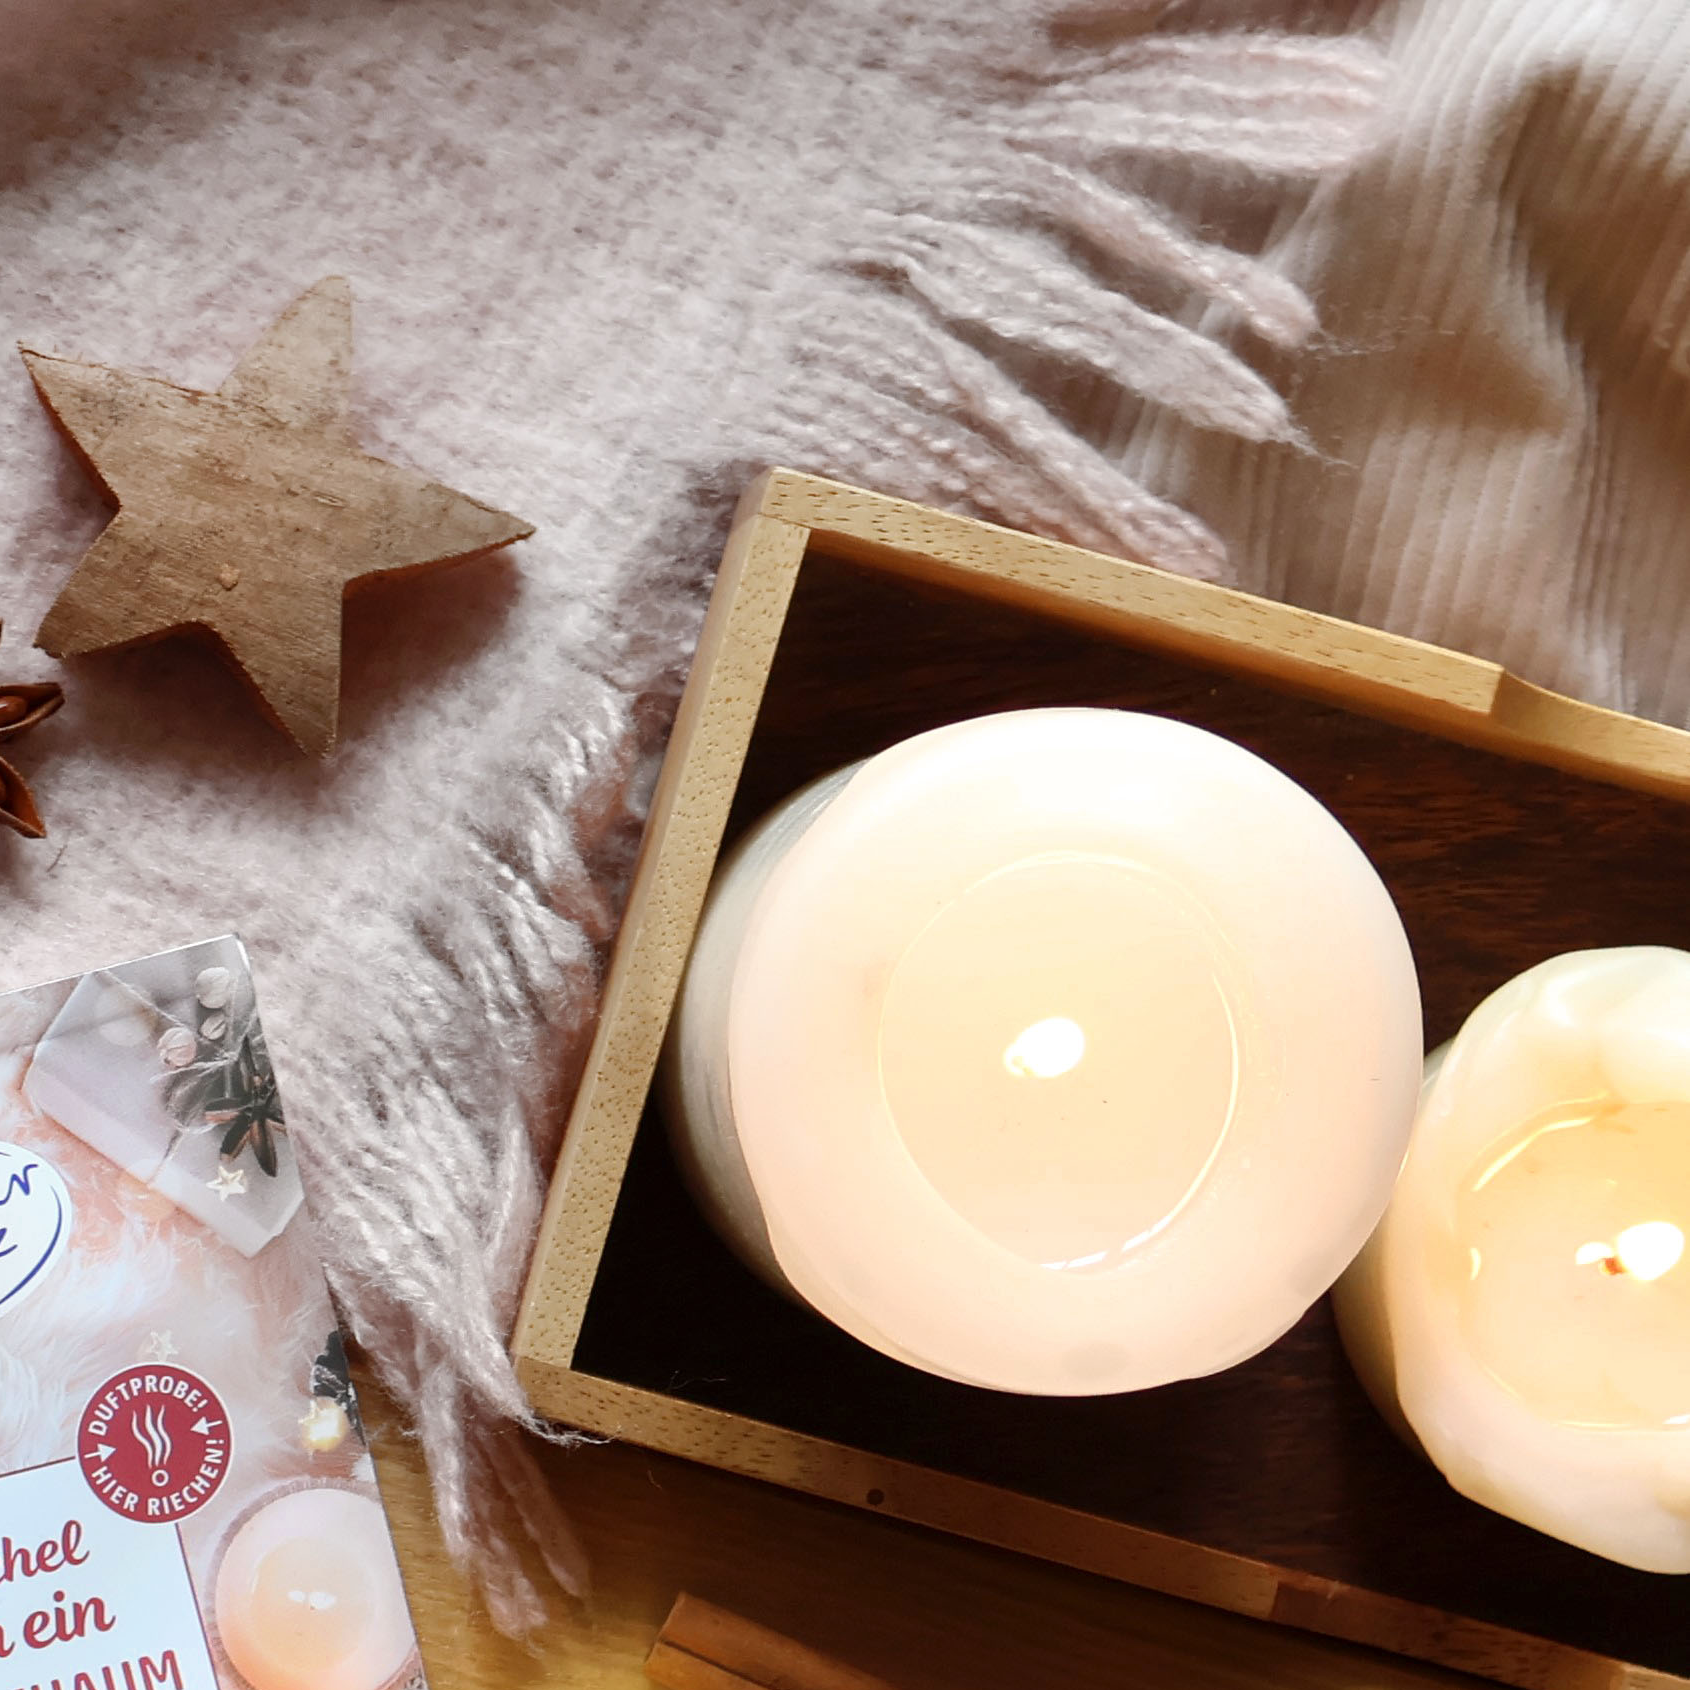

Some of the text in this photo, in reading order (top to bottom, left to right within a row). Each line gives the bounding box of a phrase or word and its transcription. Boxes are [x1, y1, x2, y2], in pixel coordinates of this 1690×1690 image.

[87, 1374, 208, 1436] DUFTPROBE!
[91, 1439, 225, 1516] HIER RIECHEN!
[23, 1590, 116, 1649] ein
